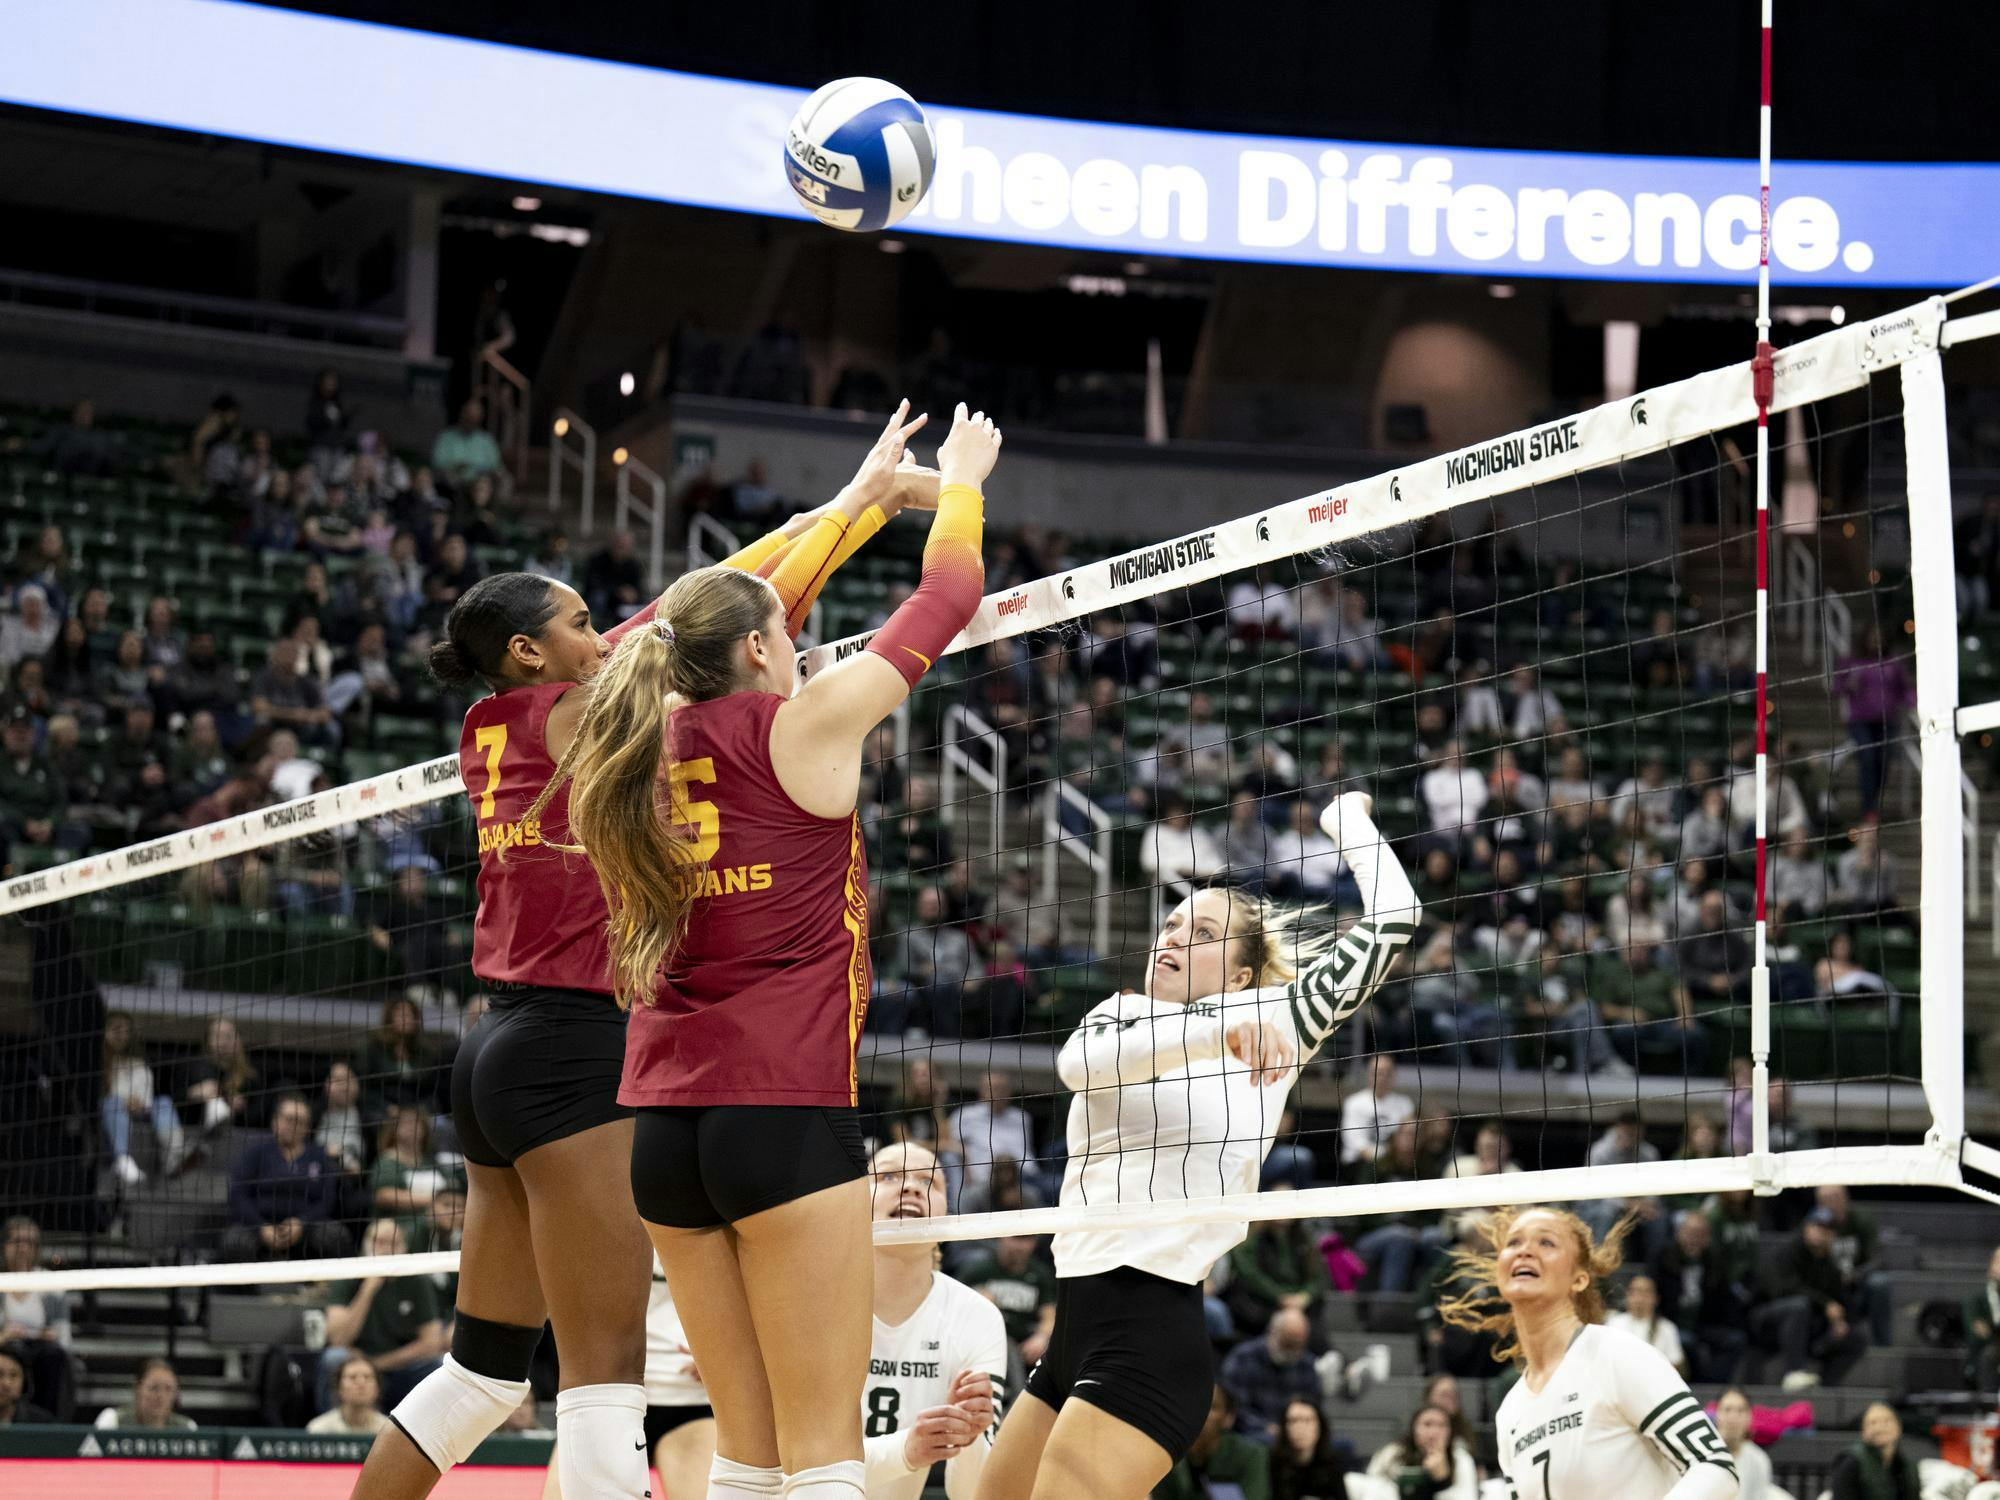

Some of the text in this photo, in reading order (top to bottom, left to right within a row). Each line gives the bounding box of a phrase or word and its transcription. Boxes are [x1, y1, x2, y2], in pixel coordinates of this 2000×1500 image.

[1238, 149, 1873, 273] Difference.
[1880, 318, 1915, 336] Senoh
[1446, 420, 1580, 489] MICHIGAN STATE
[1308, 496, 1348, 524] meijer
[1109, 532, 1215, 589] MICHIGAN STATE
[997, 592, 1028, 617] meijer
[475, 724, 508, 819] 7
[668, 757, 720, 865] 5
[870, 1359, 940, 1378] GAN STATE
[865, 1386, 900, 1438] 8
[1514, 1411, 1583, 1457] MICHIGAN STATE
[106, 1438, 209, 1457] ACRISURE
[260, 1440, 361, 1459] ACRISURE
[1532, 1448, 1552, 1500] 7
